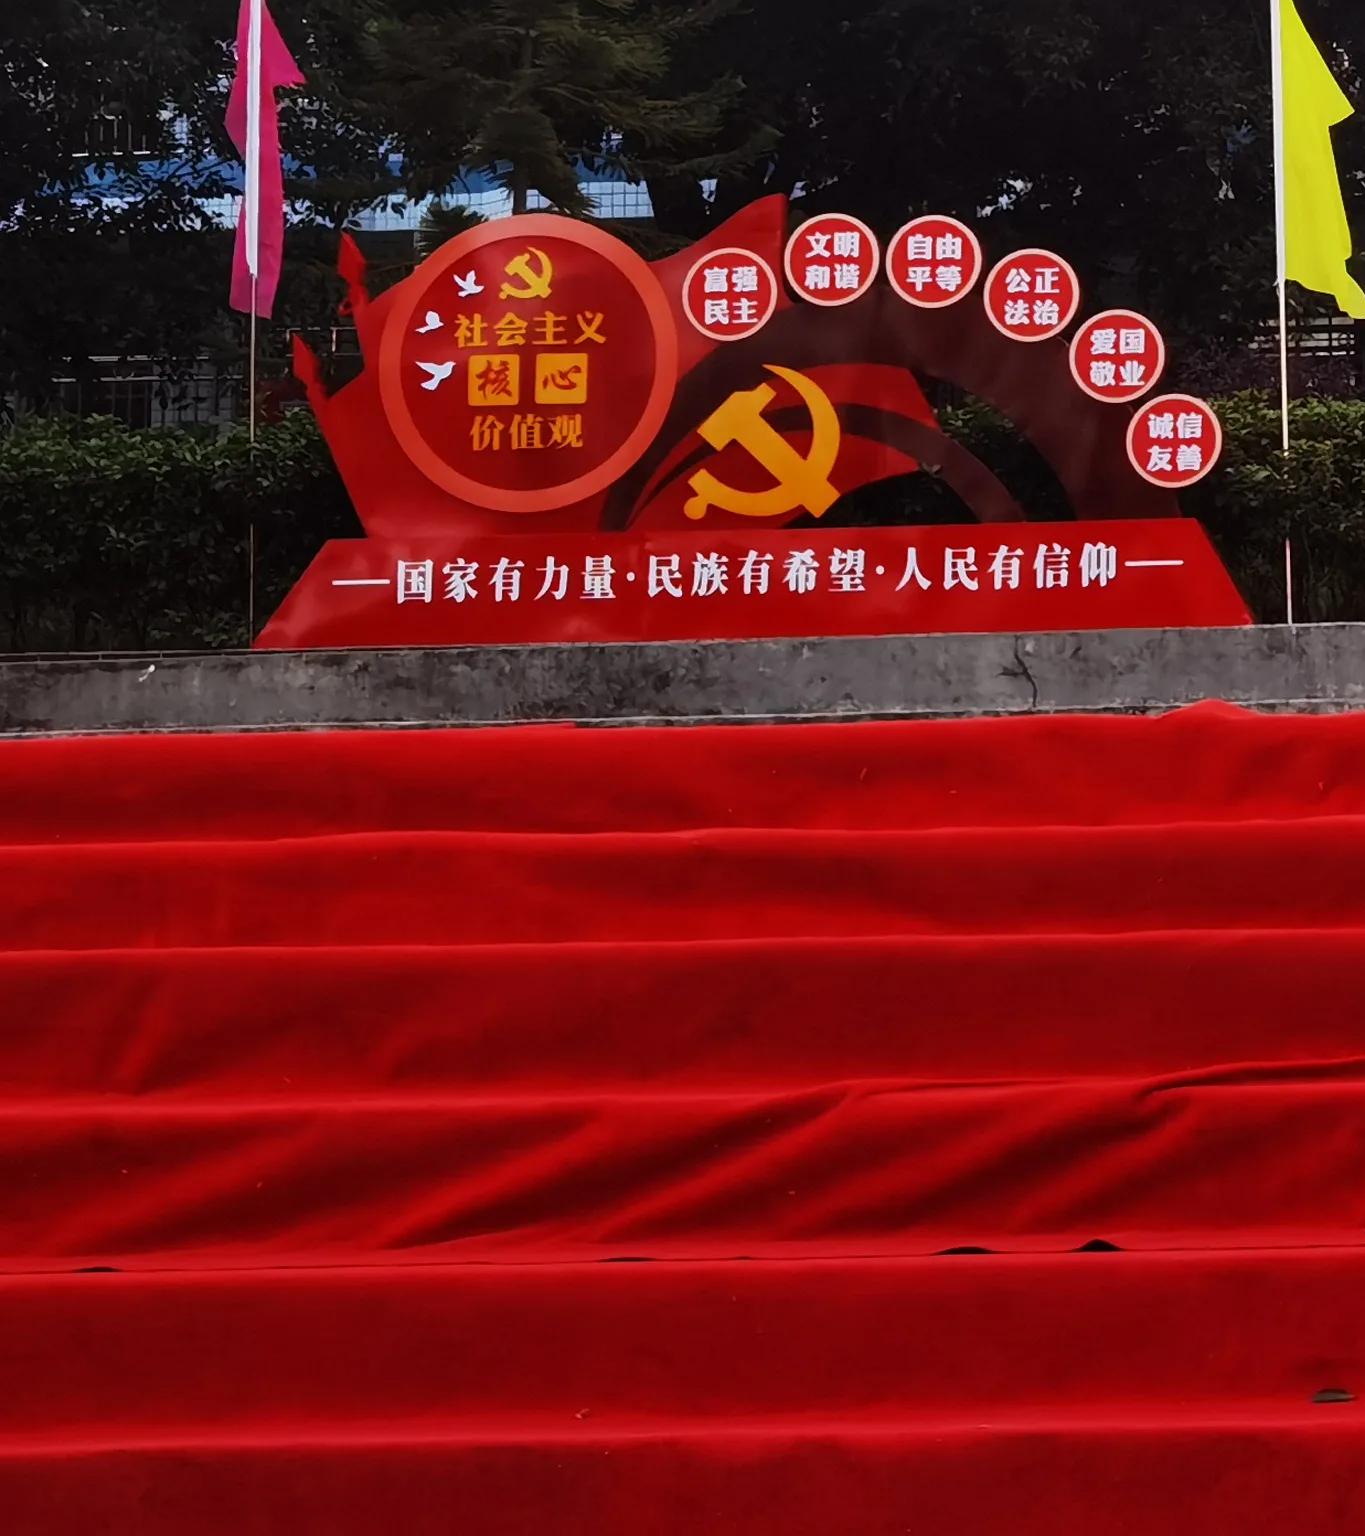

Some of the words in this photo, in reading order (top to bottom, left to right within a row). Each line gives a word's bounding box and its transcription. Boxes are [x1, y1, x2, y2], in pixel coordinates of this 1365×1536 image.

[804, 230, 861, 259] 文明
[906, 232, 963, 261] 自由
[703, 265, 759, 294] 富强
[804, 263, 861, 291] 和谐
[906, 265, 963, 292] 平等
[1004, 266, 1061, 294] 公正
[703, 297, 759, 326] 民主
[1004, 298, 1061, 326] 法治
[454, 310, 607, 349] 社会主义
[1089, 327, 1146, 356] 爱国
[474, 358, 583, 400] 核心
[1089, 360, 1147, 387] 敬业
[469, 413, 584, 452] 价值观
[1147, 411, 1204, 440] 诚信
[1146, 443, 1203, 472] 友善
